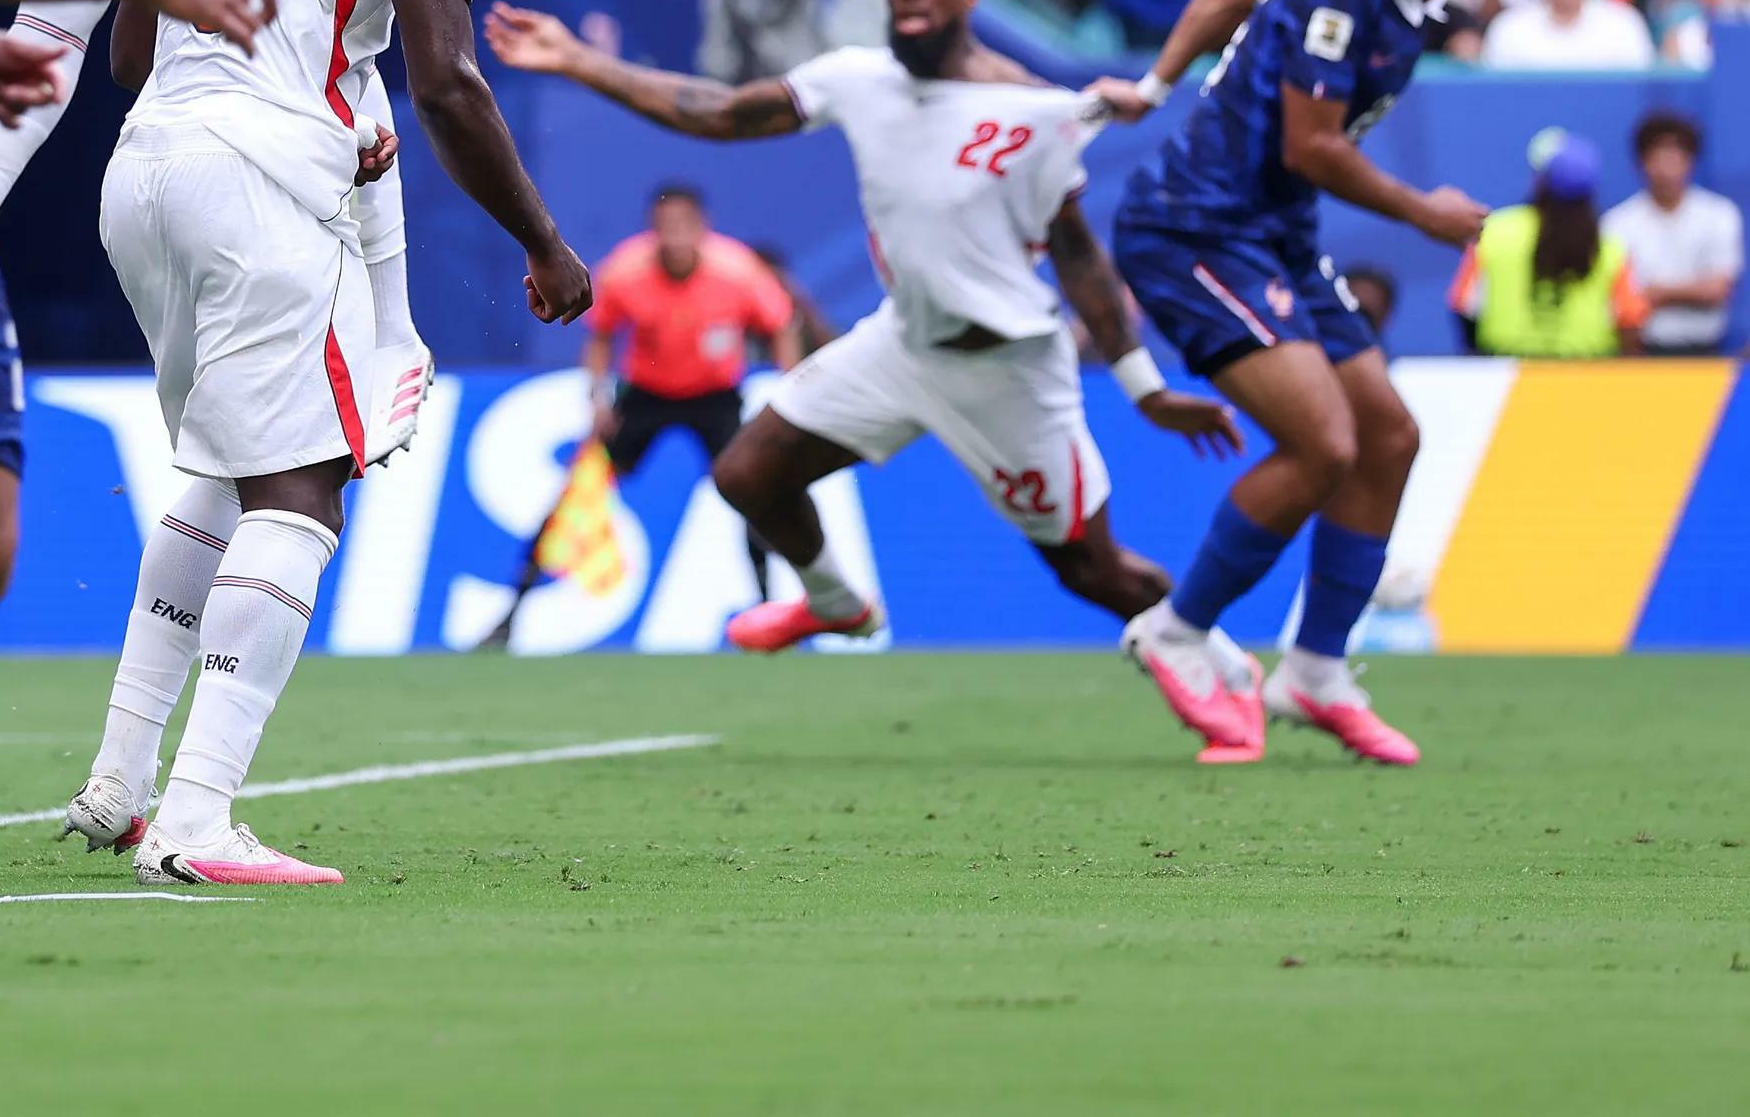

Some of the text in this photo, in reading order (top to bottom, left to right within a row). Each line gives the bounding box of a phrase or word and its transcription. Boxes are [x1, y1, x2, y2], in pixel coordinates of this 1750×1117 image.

[957, 120, 1035, 176] 22
[150, 596, 198, 630] ENG
[204, 653, 240, 674] ENG
